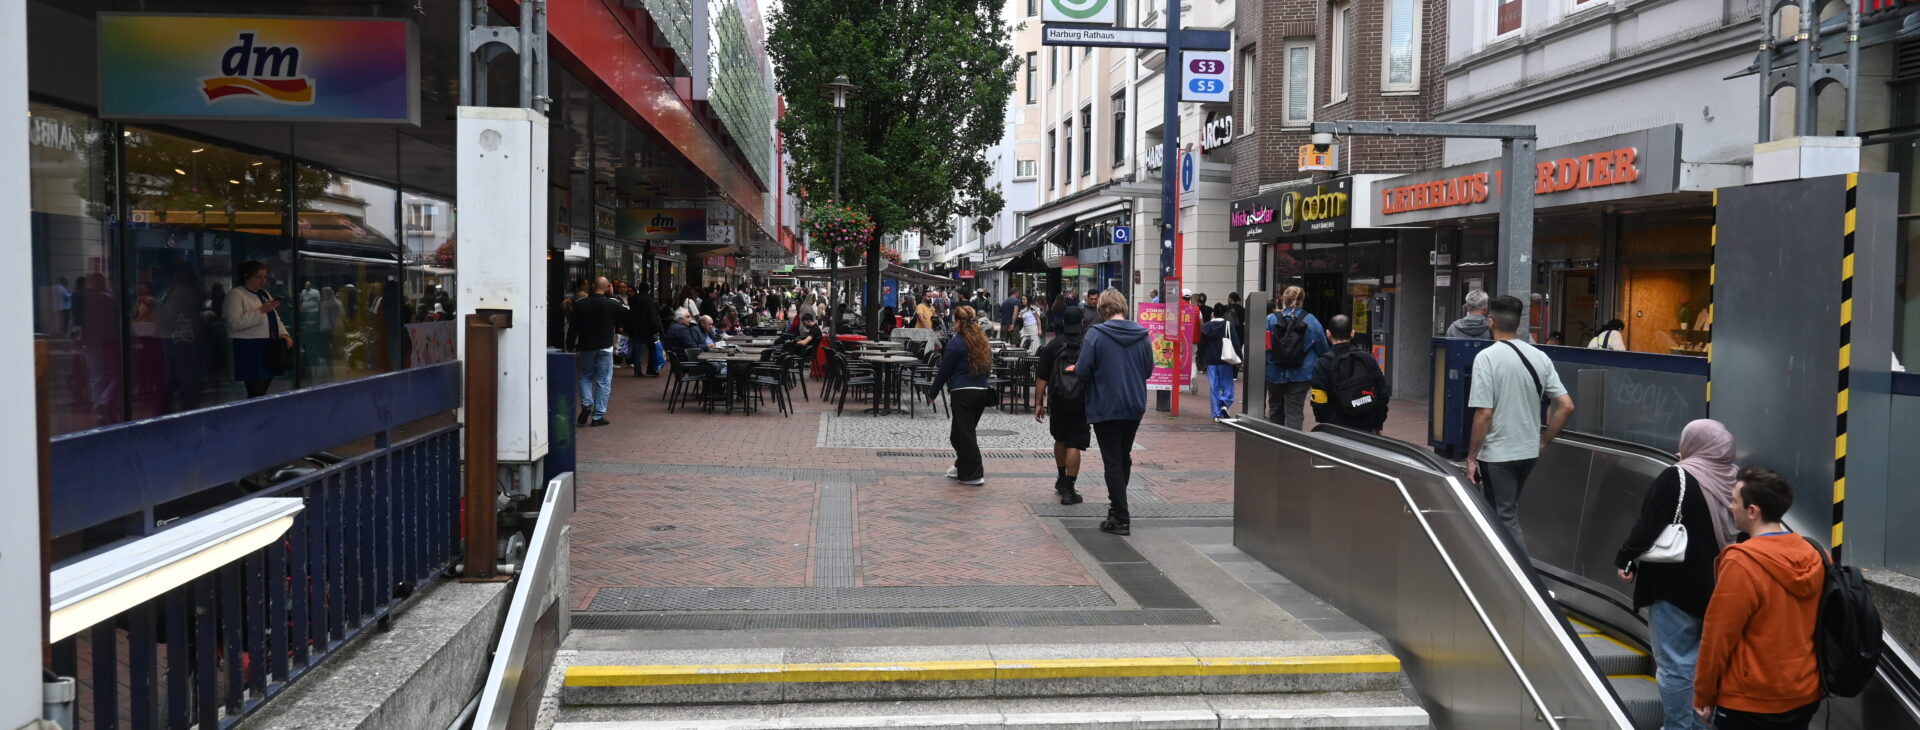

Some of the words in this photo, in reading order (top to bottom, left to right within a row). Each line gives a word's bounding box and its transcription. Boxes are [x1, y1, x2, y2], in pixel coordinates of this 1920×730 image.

[1050, 30, 1081, 40] Harburg
[1083, 31, 1115, 40] Rathaus
[221, 33, 299, 77] dm
[1201, 115, 1233, 150] ARCAD
[1145, 143, 1164, 169] HARB
[1381, 172, 1489, 214] LEIHHAUS
[1495, 147, 1639, 195] RDIER
[652, 213, 674, 226] dm
[1351, 394, 1373, 408] PUMA
